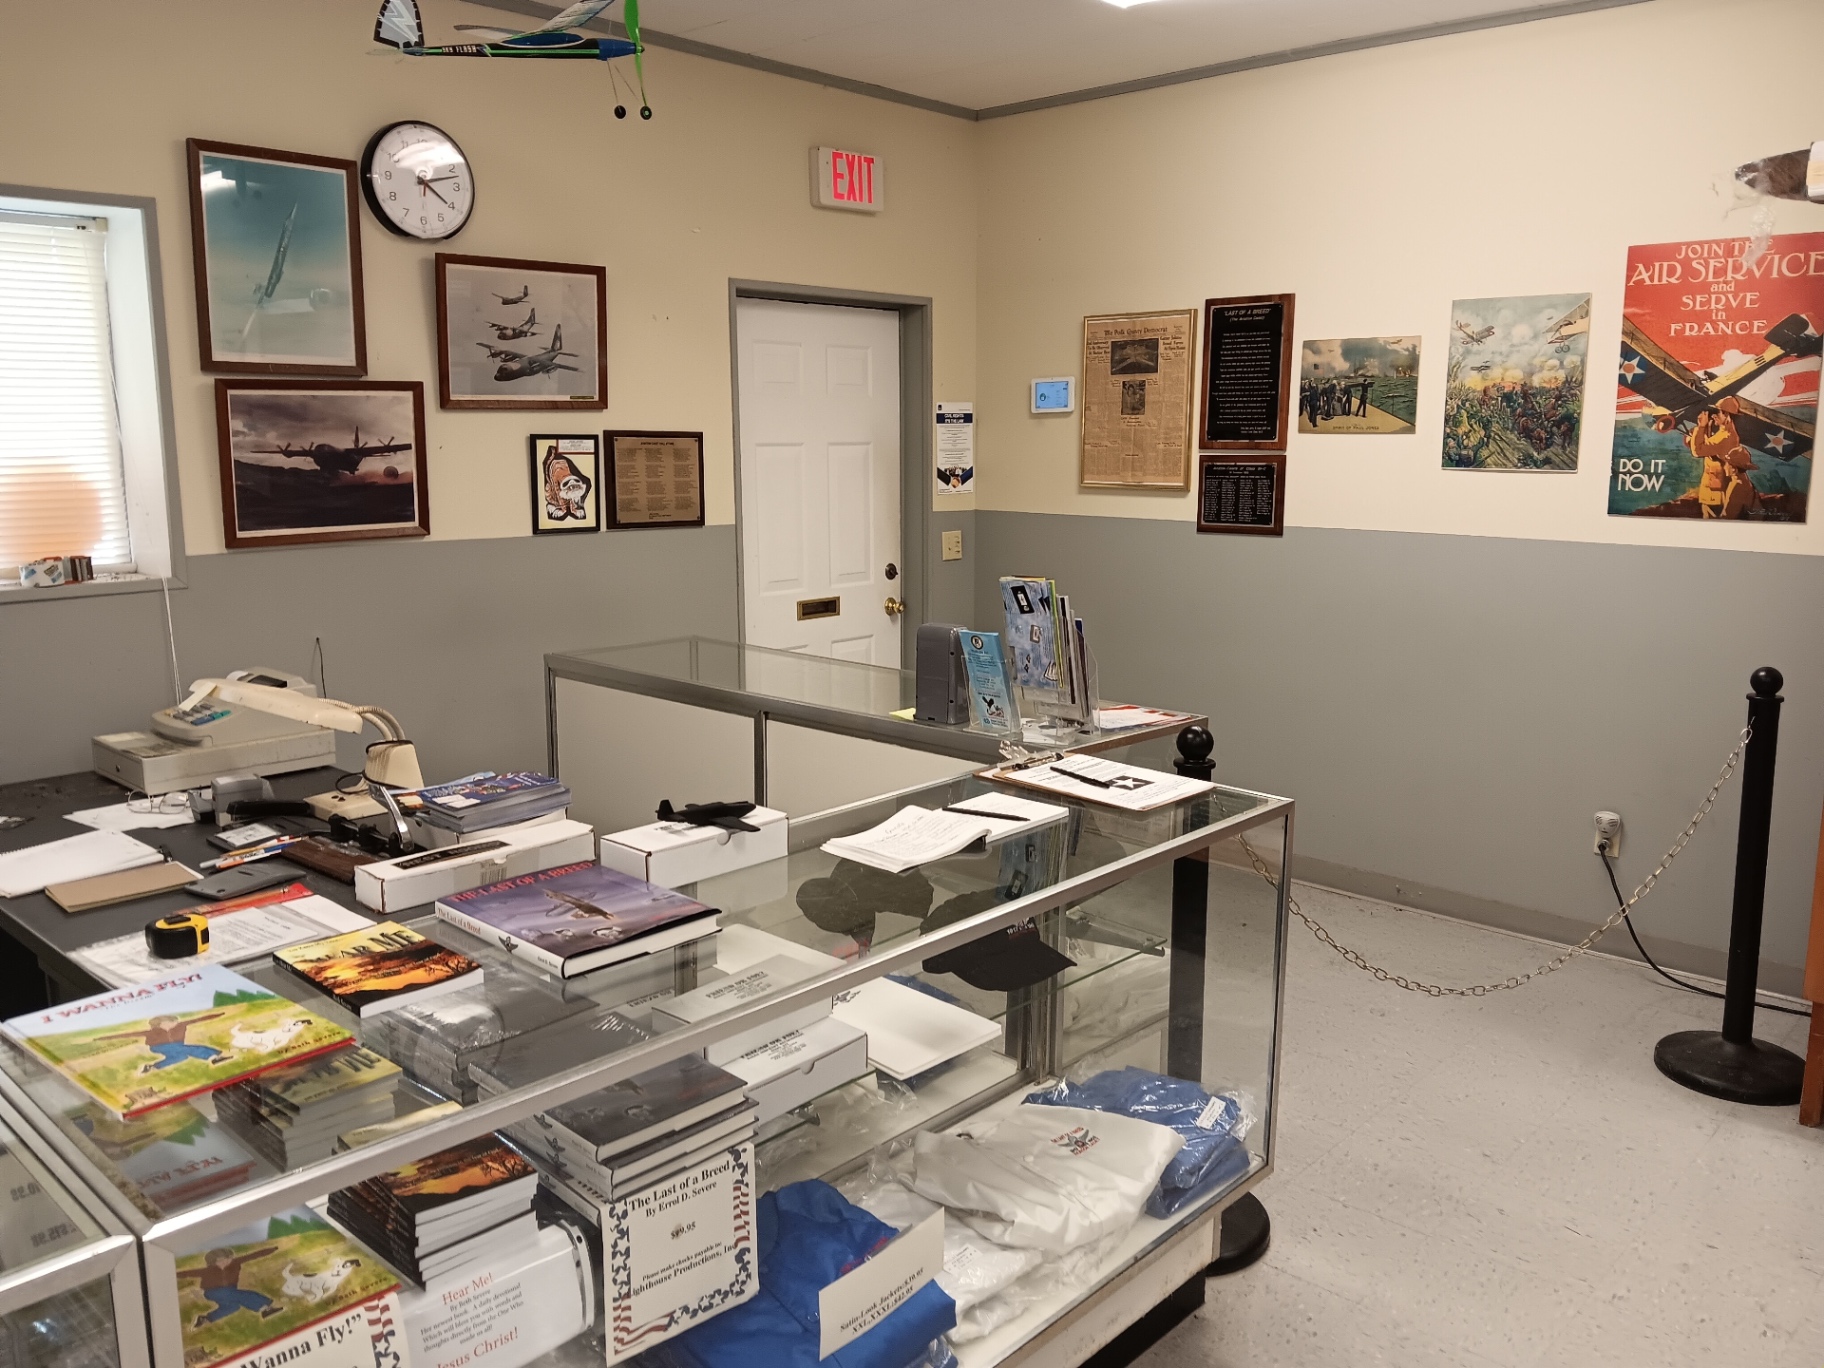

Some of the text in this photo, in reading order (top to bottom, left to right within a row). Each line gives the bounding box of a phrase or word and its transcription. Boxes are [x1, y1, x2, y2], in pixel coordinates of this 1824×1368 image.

[384, 170, 393, 181] 9
[448, 164, 456, 174] 2
[831, 150, 875, 205] EXIT
[389, 191, 397, 201] 8
[452, 182, 461, 192] 3
[402, 207, 410, 217] 7
[447, 201, 456, 211] 4
[420, 216, 428, 226] 6
[437, 212, 445, 223] 5
[1675, 243, 1725, 259] JOIN
[1627, 251, 1824, 286] AIR SERVICE
[1710, 281, 1735, 293] and
[1680, 292, 1760, 311] SERVE
[1712, 309, 1726, 320] in
[1669, 320, 1769, 337] FRANCE
[1619, 459, 1667, 473] DO IT
[1617, 473, 1665, 492] NOW
[452, 861, 594, 902] THE LAST OF A BREED
[369, 930, 416, 951] ME
[41, 973, 203, 1024] I WANNA FLY!
[628, 1160, 731, 1212] The Last of a Breed
[645, 1181, 717, 1218] By Errol D. Severe
[632, 1272, 672, 1296] ighthouse
[673, 1249, 722, 1277] Productions,
[642, 1270, 660, 1282] Please
[660, 1263, 675, 1275] make
[675, 1254, 694, 1267] checks
[694, 1246, 714, 1259] payable
[442, 1272, 493, 1306] Hear Me!
[420, 1326, 432, 1336] Her
[433, 1316, 453, 1330] newest
[478, 1298, 492, 1308] daily
[492, 1282, 522, 1301] devotional
[449, 1304, 458, 1312] By
[459, 1297, 472, 1307] Beth
[422, 1291, 523, 1344] Which will bless you with words and
[423, 1301, 524, 1353] thoughts directly from the One Who
[459, 1332, 476, 1345] made
[473, 1326, 518, 1357] Christ!
